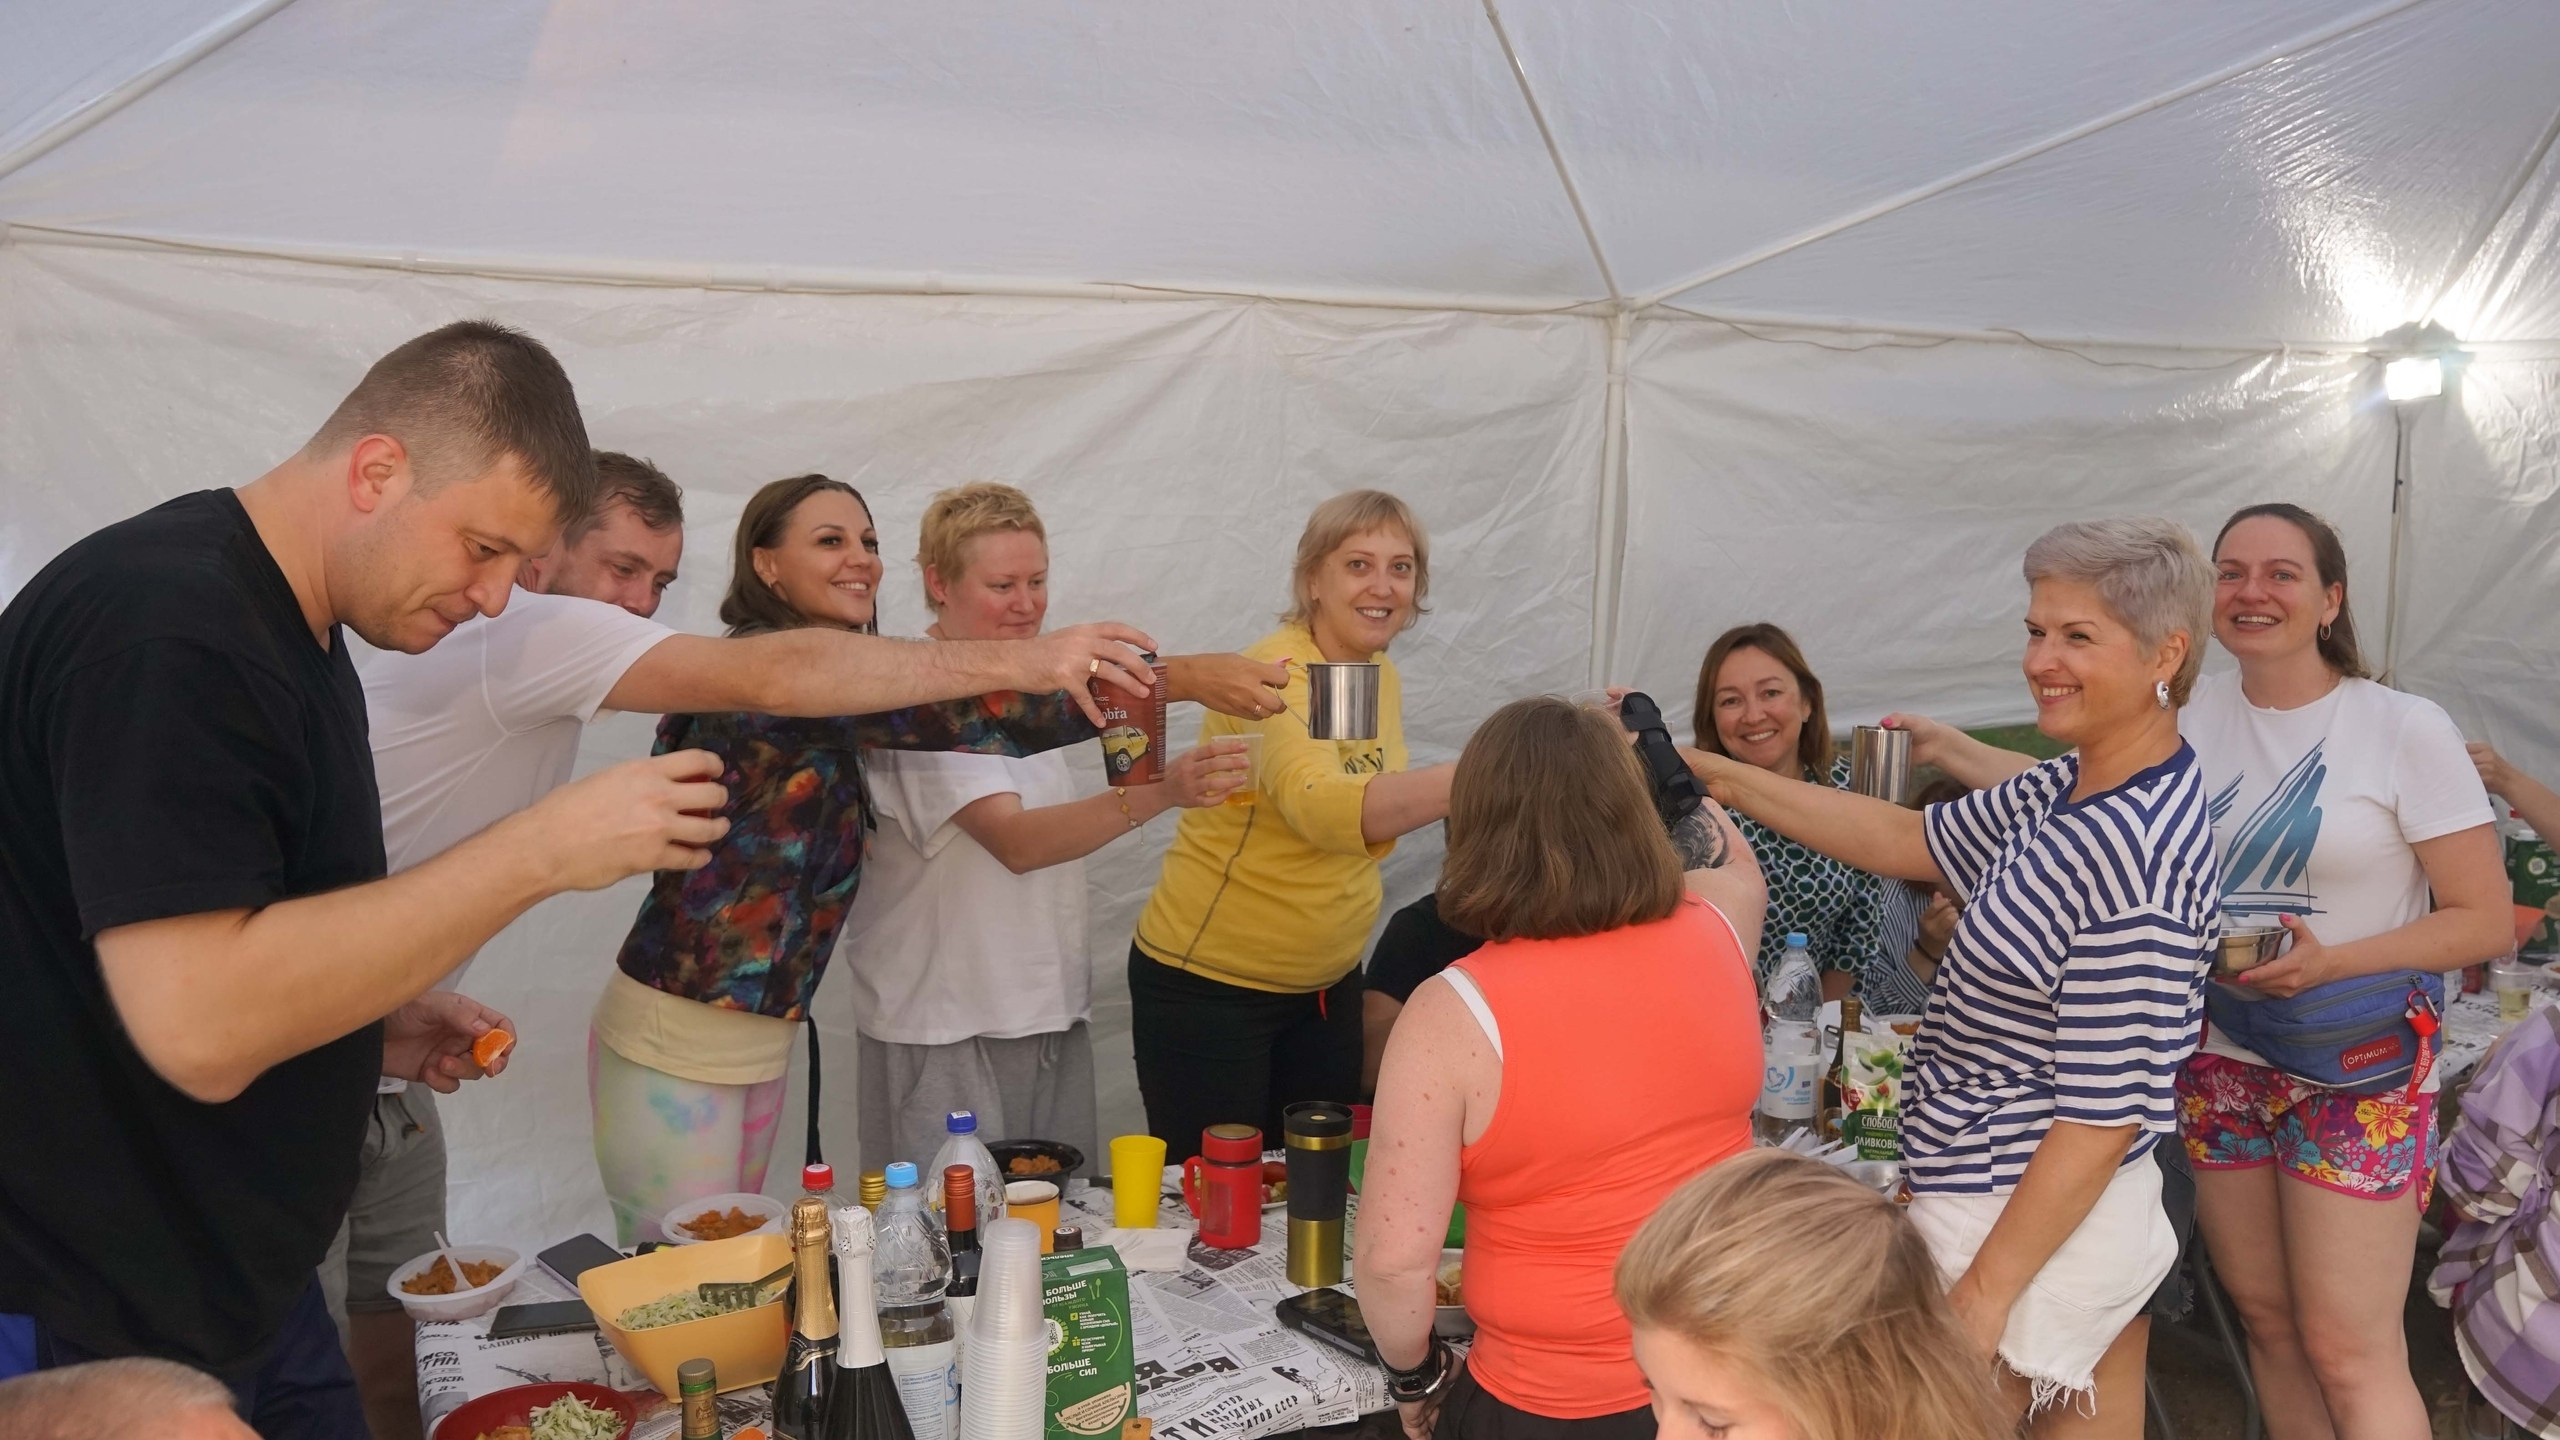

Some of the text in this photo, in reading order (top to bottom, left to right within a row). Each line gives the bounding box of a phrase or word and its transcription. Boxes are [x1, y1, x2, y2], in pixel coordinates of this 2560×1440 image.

[1102, 707, 1128, 720] obřa
[1861, 1116, 1898, 1130] СЛОБОДА
[1854, 1135, 1898, 1150] ОЛИВКОВЫ
[1046, 1279, 1088, 1297] БОЛЬШЕ
[478, 1335, 541, 1351] КАПИТАН
[1047, 1357, 1092, 1375] БОЛЬШЕ
[1079, 1367, 1098, 1377] СИЛ
[1274, 1394, 1300, 1415] СССР
